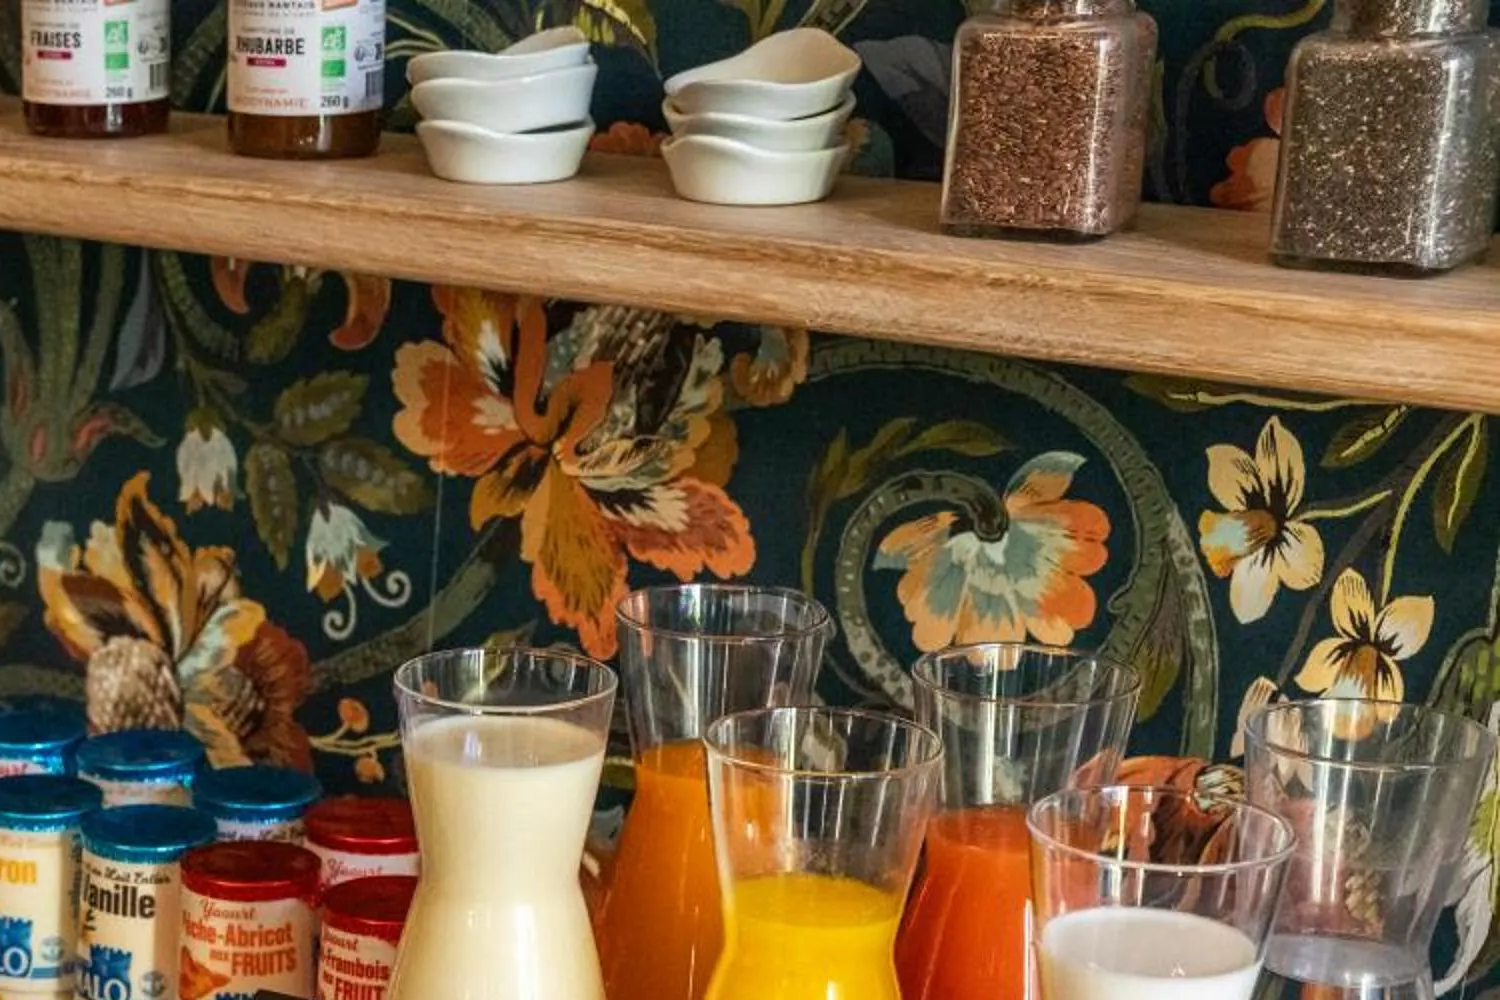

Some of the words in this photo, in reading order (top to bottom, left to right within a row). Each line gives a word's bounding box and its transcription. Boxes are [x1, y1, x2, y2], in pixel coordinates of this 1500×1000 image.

[30, 30, 82, 48] FRAISES
[321, 95, 342, 108] 260
[231, 947, 297, 977] FRUITS
